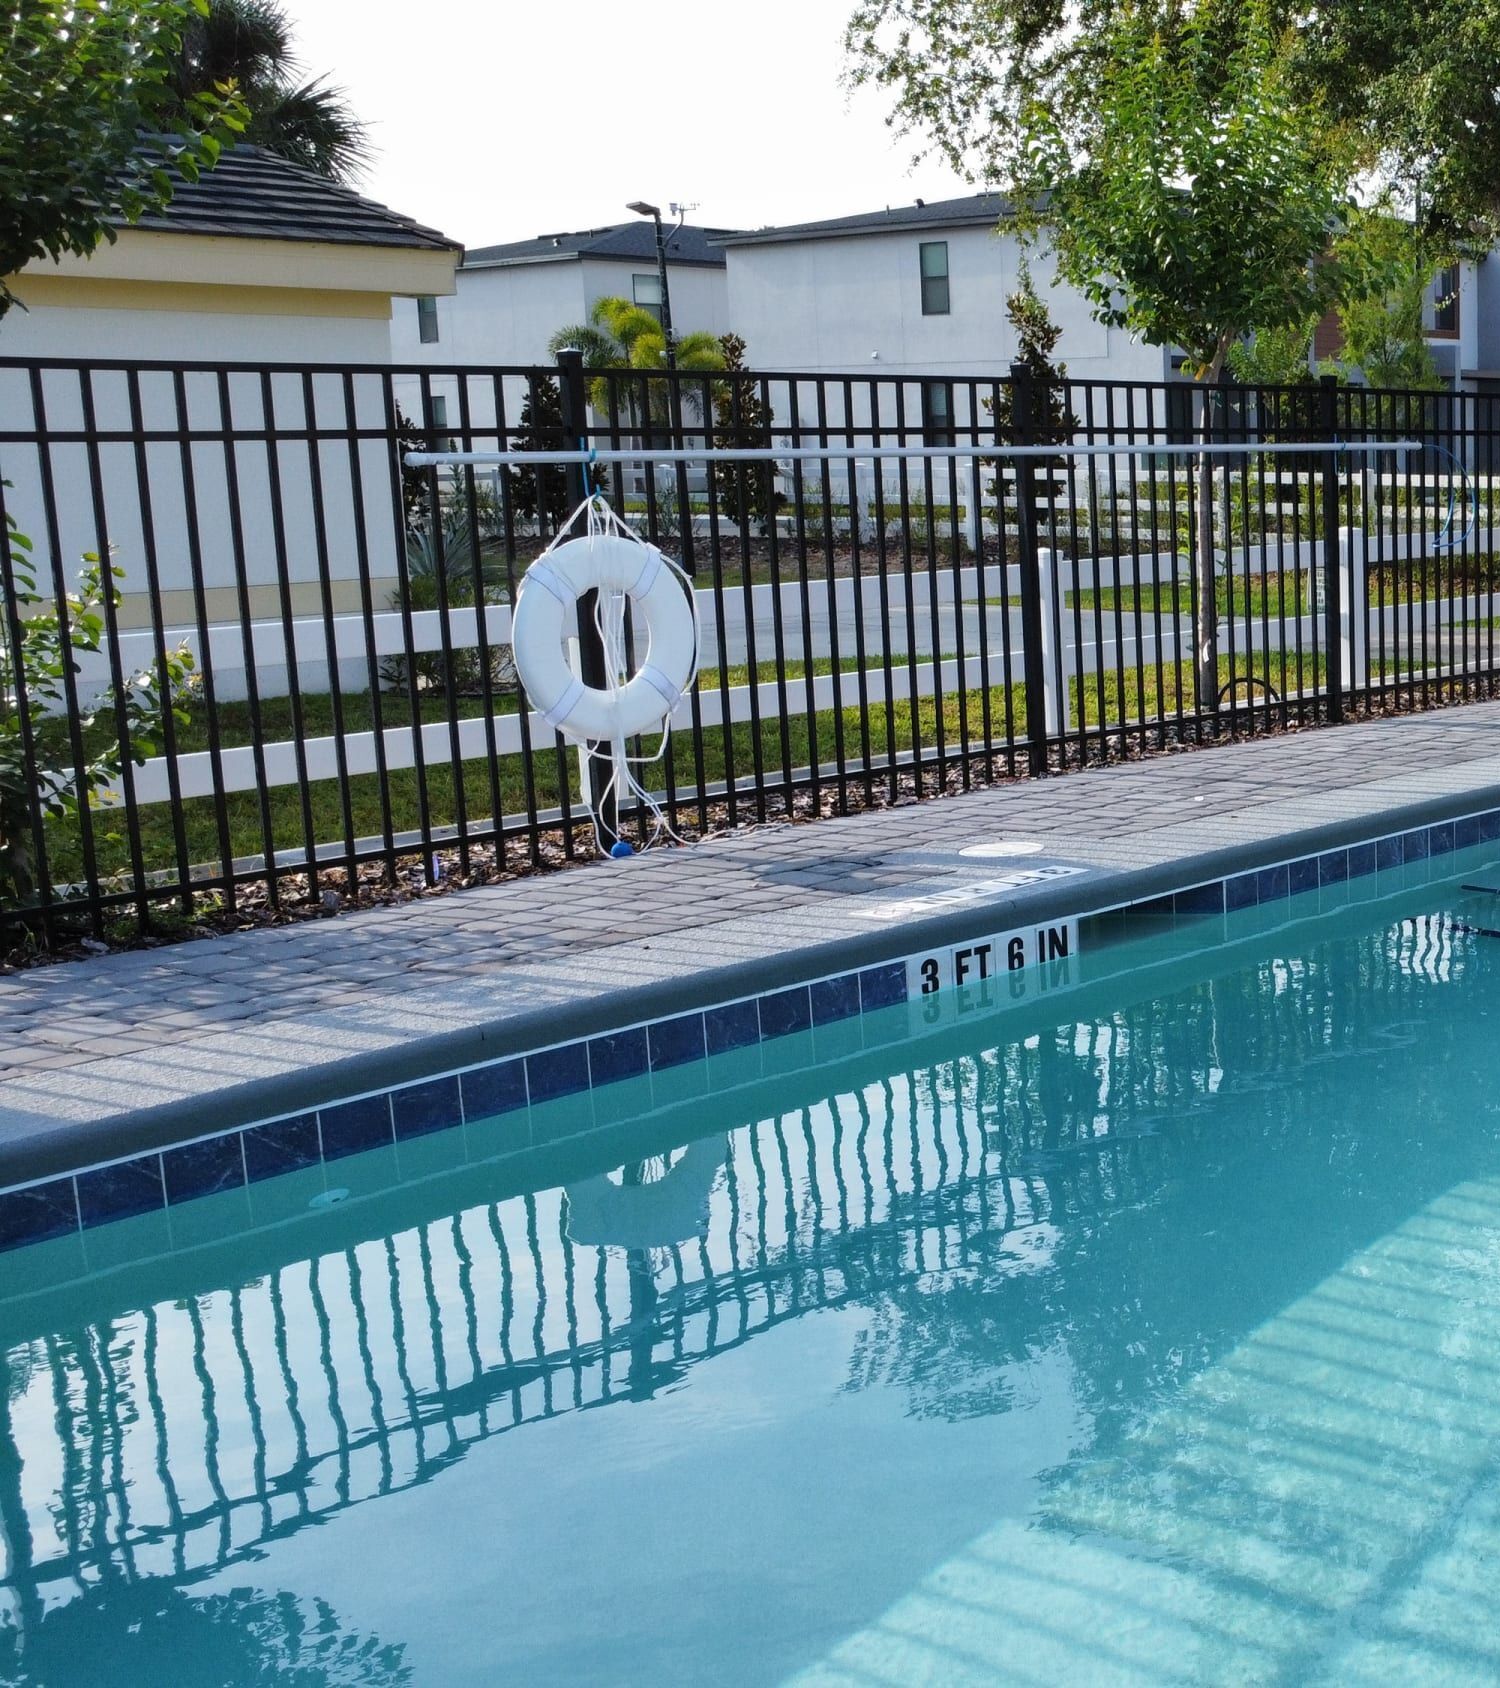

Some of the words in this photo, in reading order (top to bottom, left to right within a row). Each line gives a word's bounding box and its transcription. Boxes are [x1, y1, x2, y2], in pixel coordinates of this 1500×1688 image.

[920, 958, 940, 995] 3
[955, 944, 992, 986] FT
[1007, 937, 1025, 971] 6
[1038, 925, 1069, 963] IN
